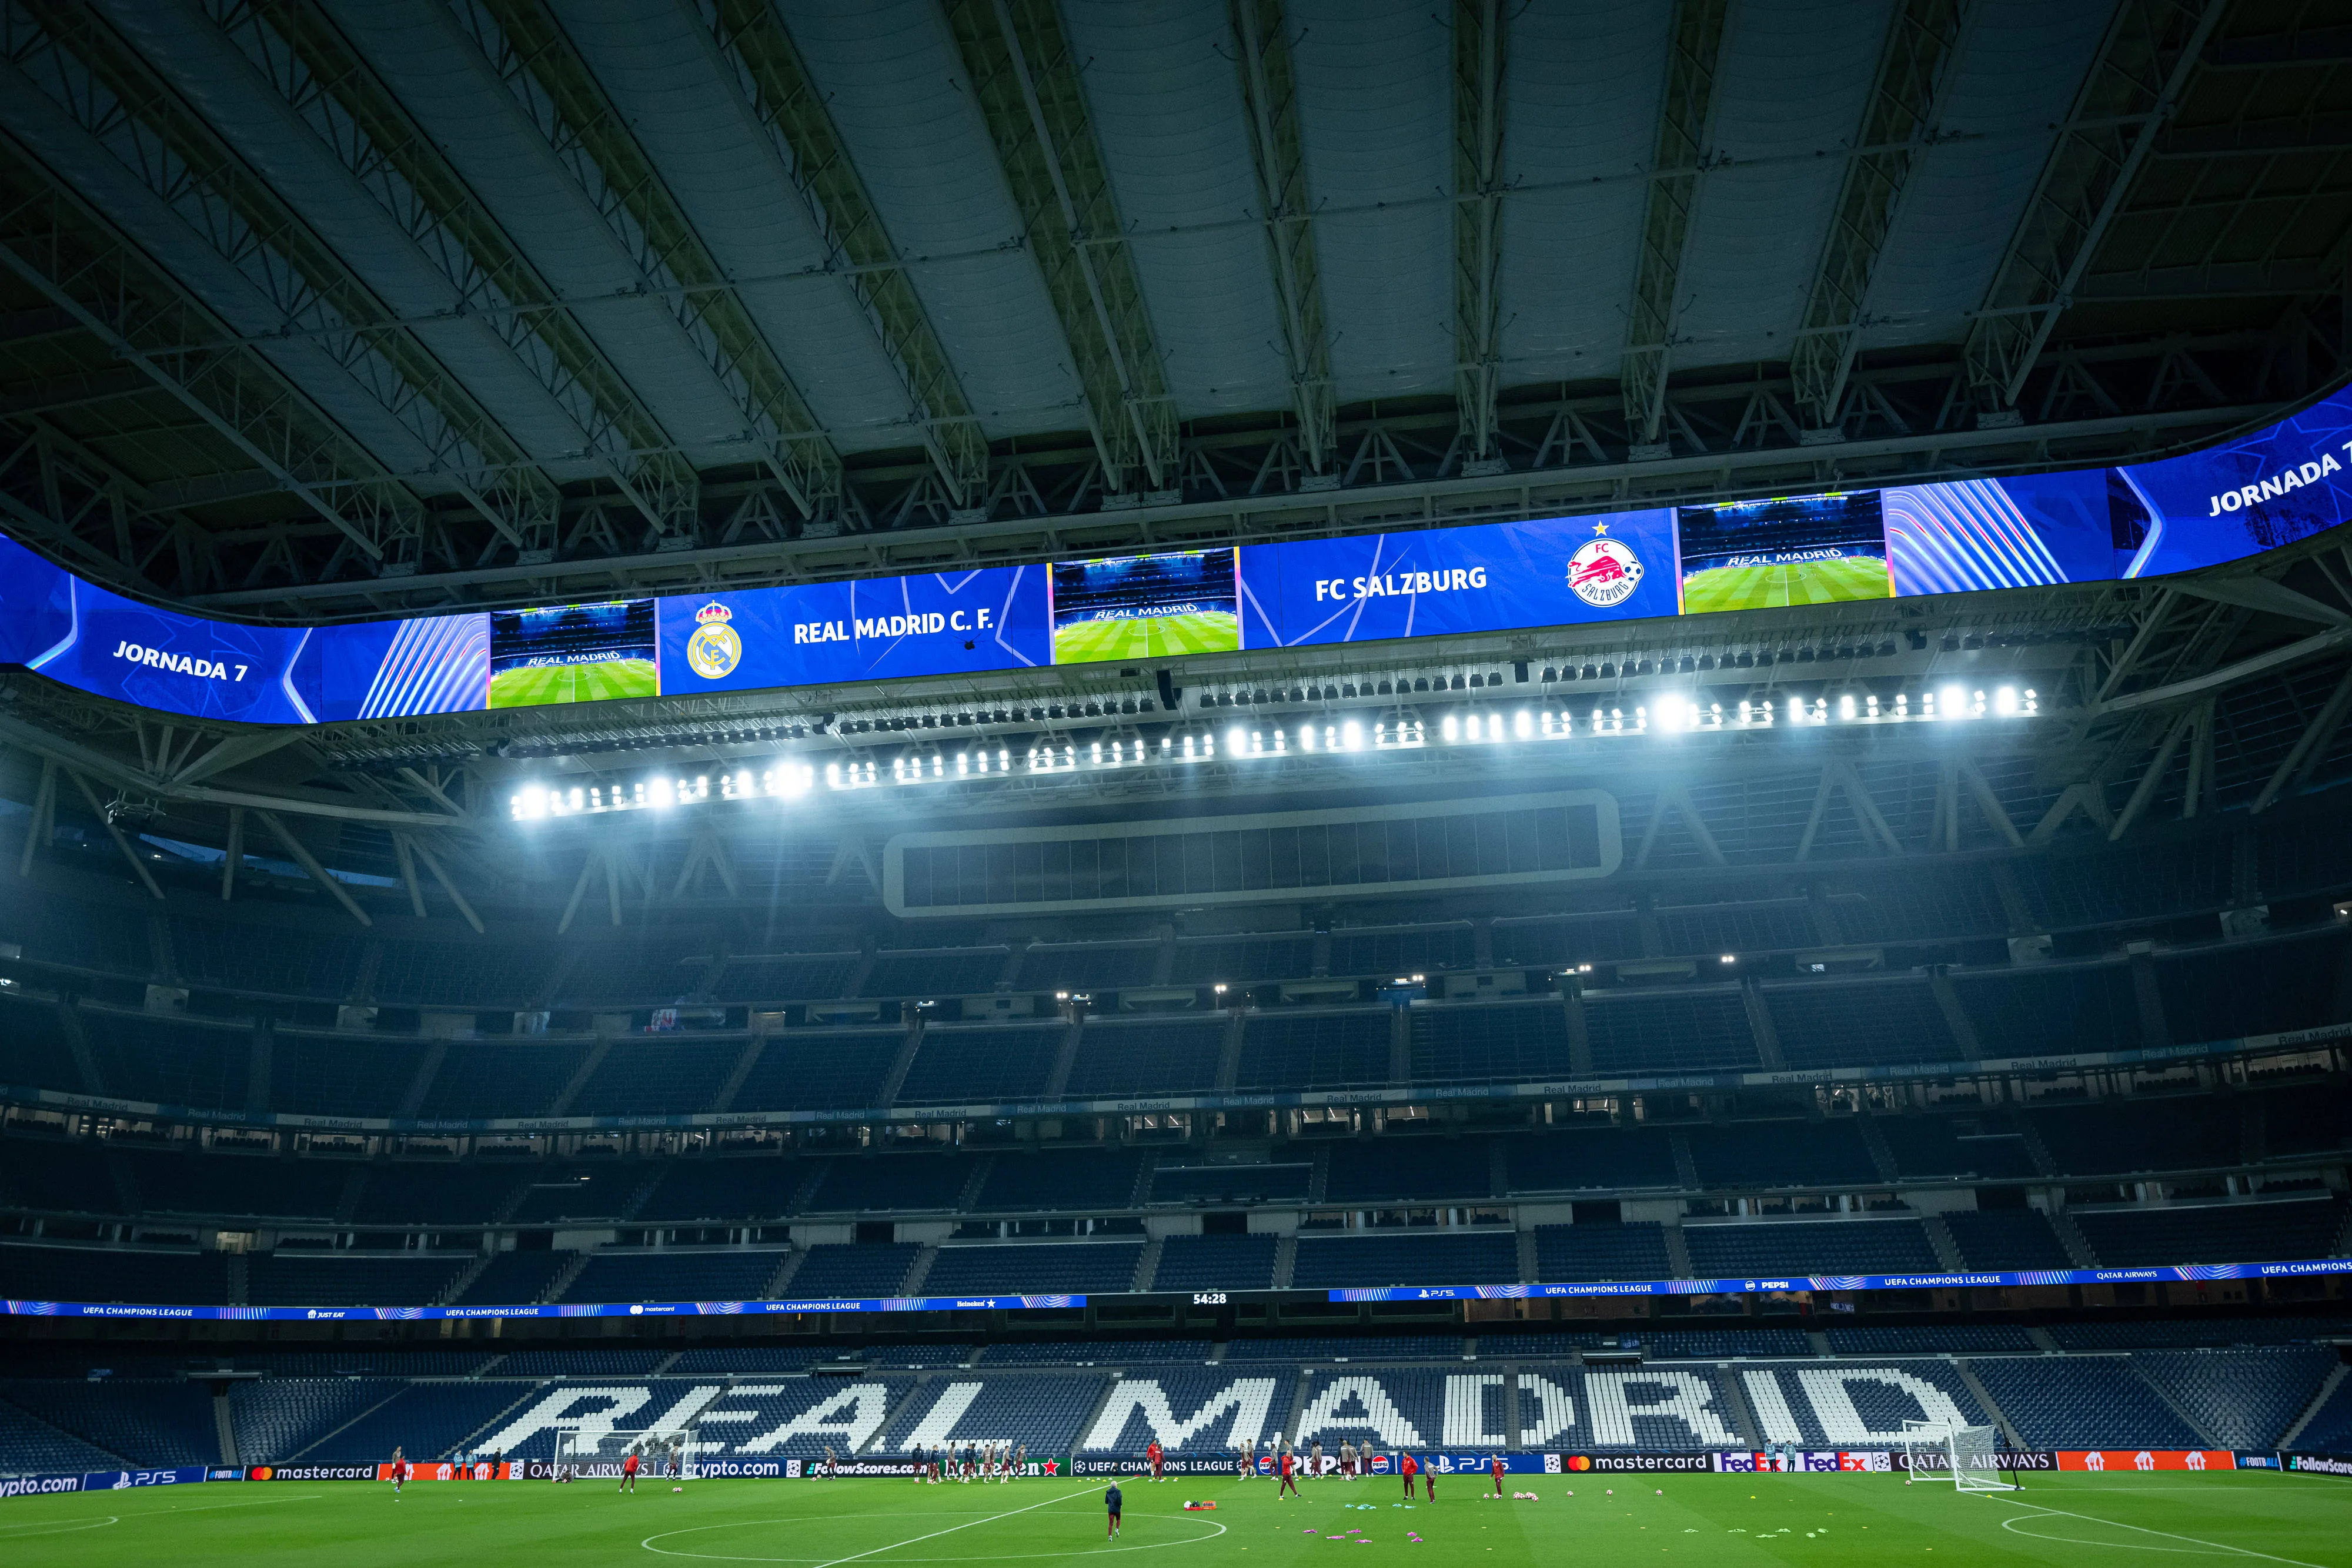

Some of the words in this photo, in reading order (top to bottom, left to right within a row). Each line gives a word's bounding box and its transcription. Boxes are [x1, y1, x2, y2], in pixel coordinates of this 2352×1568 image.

[2209, 453, 2342, 517] JORNADA
[1595, 543, 1609, 553] FC
[1728, 556, 1772, 566] REAL
[1776, 549, 1842, 563] MADRID
[1315, 579, 1346, 601] FC
[1352, 567, 1486, 600] SALZBURG
[1582, 581, 1629, 601] SALZBURG
[1094, 610, 1134, 620] REAL
[1138, 604, 1198, 616] MADRID
[794, 620, 850, 644] REAL
[856, 612, 945, 640] MADRID
[950, 610, 972, 631] C.
[977, 608, 994, 630] F.
[113, 640, 227, 680] JORNADA
[235, 664, 248, 682] 7
[528, 656, 564, 666] REAL
[566, 651, 621, 663] MADRID
[2278, 1034, 2305, 1046] Real
[2308, 1027, 2351, 1041] Madrid
[2141, 1049, 2166, 1059] Real
[2169, 1044, 2209, 1055] Madrid
[1889, 1066, 1912, 1076] Real
[1914, 1064, 1949, 1074] Madrid
[2011, 1061, 2035, 1071] Real
[2039, 1058, 2077, 1068] Madrid
[1658, 1079, 1678, 1088] Real
[1681, 1077, 1714, 1086] Madrid
[1772, 1075, 1794, 1084] Real
[1797, 1071, 1832, 1082] Madrid
[1435, 1089, 1455, 1097] Real
[1458, 1088, 1489, 1096] Madrid
[1544, 1085, 1565, 1094] Real
[1568, 1084, 1601, 1093] Madrid
[67, 1096, 90, 1107] Real
[92, 1099, 128, 1111] Madrid
[1223, 1097, 1242, 1106] Real
[1244, 1096, 1274, 1105] Madrid
[1327, 1095, 1347, 1103] Real
[1349, 1094, 1382, 1102] Madrid
[1017, 1105, 1035, 1114] Real
[1037, 1104, 1067, 1113] Madrid
[1117, 1103, 1137, 1111] Real
[1140, 1101, 1170, 1110] Madrid
[187, 1109, 209, 1118] Real
[212, 1111, 246, 1121] Madrid
[716, 1116, 735, 1124] Real
[737, 1115, 767, 1124] Madrid
[816, 1111, 834, 1119] Real
[836, 1110, 865, 1119] Madrid
[914, 1110, 934, 1118] Real
[936, 1109, 967, 1118] Madrid
[304, 1118, 326, 1127] Real
[328, 1119, 363, 1128] Madrid
[417, 1121, 436, 1129] Real
[439, 1121, 469, 1129] Madrid
[517, 1121, 537, 1129] Real
[539, 1120, 569, 1129] Madrid
[617, 1117, 636, 1125] Real
[638, 1116, 667, 1125] Madrid
[2261, 1265, 2288, 1274] UEFA
[2290, 1262, 2352, 1273] CHAMPIONS
[1909, 1276, 1963, 1285] CHAMPIONS
[1965, 1275, 2001, 1283] LEAGUE
[1617, 1285, 1652, 1293] LEAGUE
[1193, 1293, 1227, 1305] 54:28
[106, 1307, 157, 1316] CHAMPIONS
[472, 1382, 1013, 1455] REAL
[1083, 1368, 1969, 1451] MADRID
[1191, 1461, 1234, 1471] LEAGUE
[1595, 1455, 1706, 1469] mastercard
[1803, 1452, 1867, 1471] FedEx
[1970, 1453, 2049, 1469] AIRWAYS
[2239, 1457, 2279, 1467] #FOOTBALL
[209, 1470, 243, 1479] #FOOTBALL
[276, 1465, 373, 1479] mastercard
[135, 1471, 176, 1486] PS5
